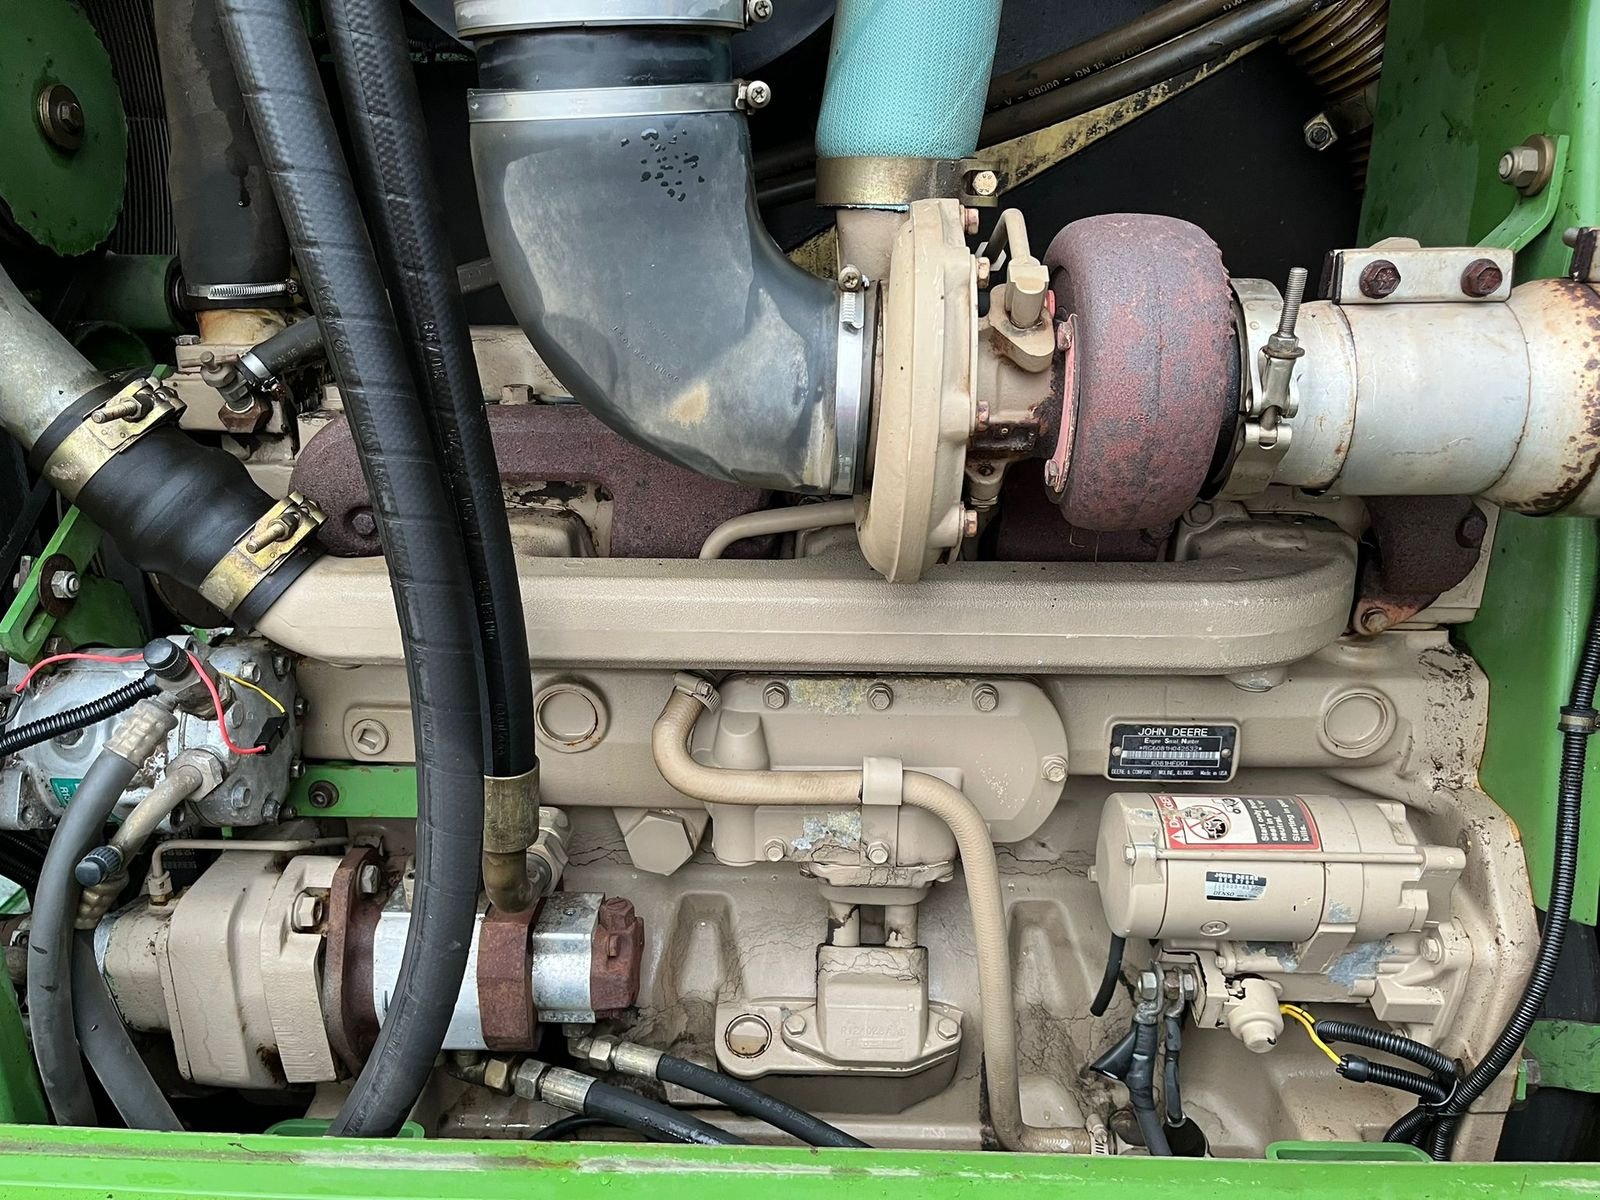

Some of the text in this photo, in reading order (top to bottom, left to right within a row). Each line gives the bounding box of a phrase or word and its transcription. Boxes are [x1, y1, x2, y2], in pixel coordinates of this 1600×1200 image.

[1138, 727, 1208, 737] JOHN DEERE
[1159, 796, 1181, 828] DAGER
[1253, 810, 1265, 823] only
[1258, 824, 1270, 841] Start
[1268, 826, 1279, 841] seat
[1273, 815, 1288, 841] neutral.
[1286, 814, 1301, 841] Starting
[1300, 824, 1310, 841] kills.
